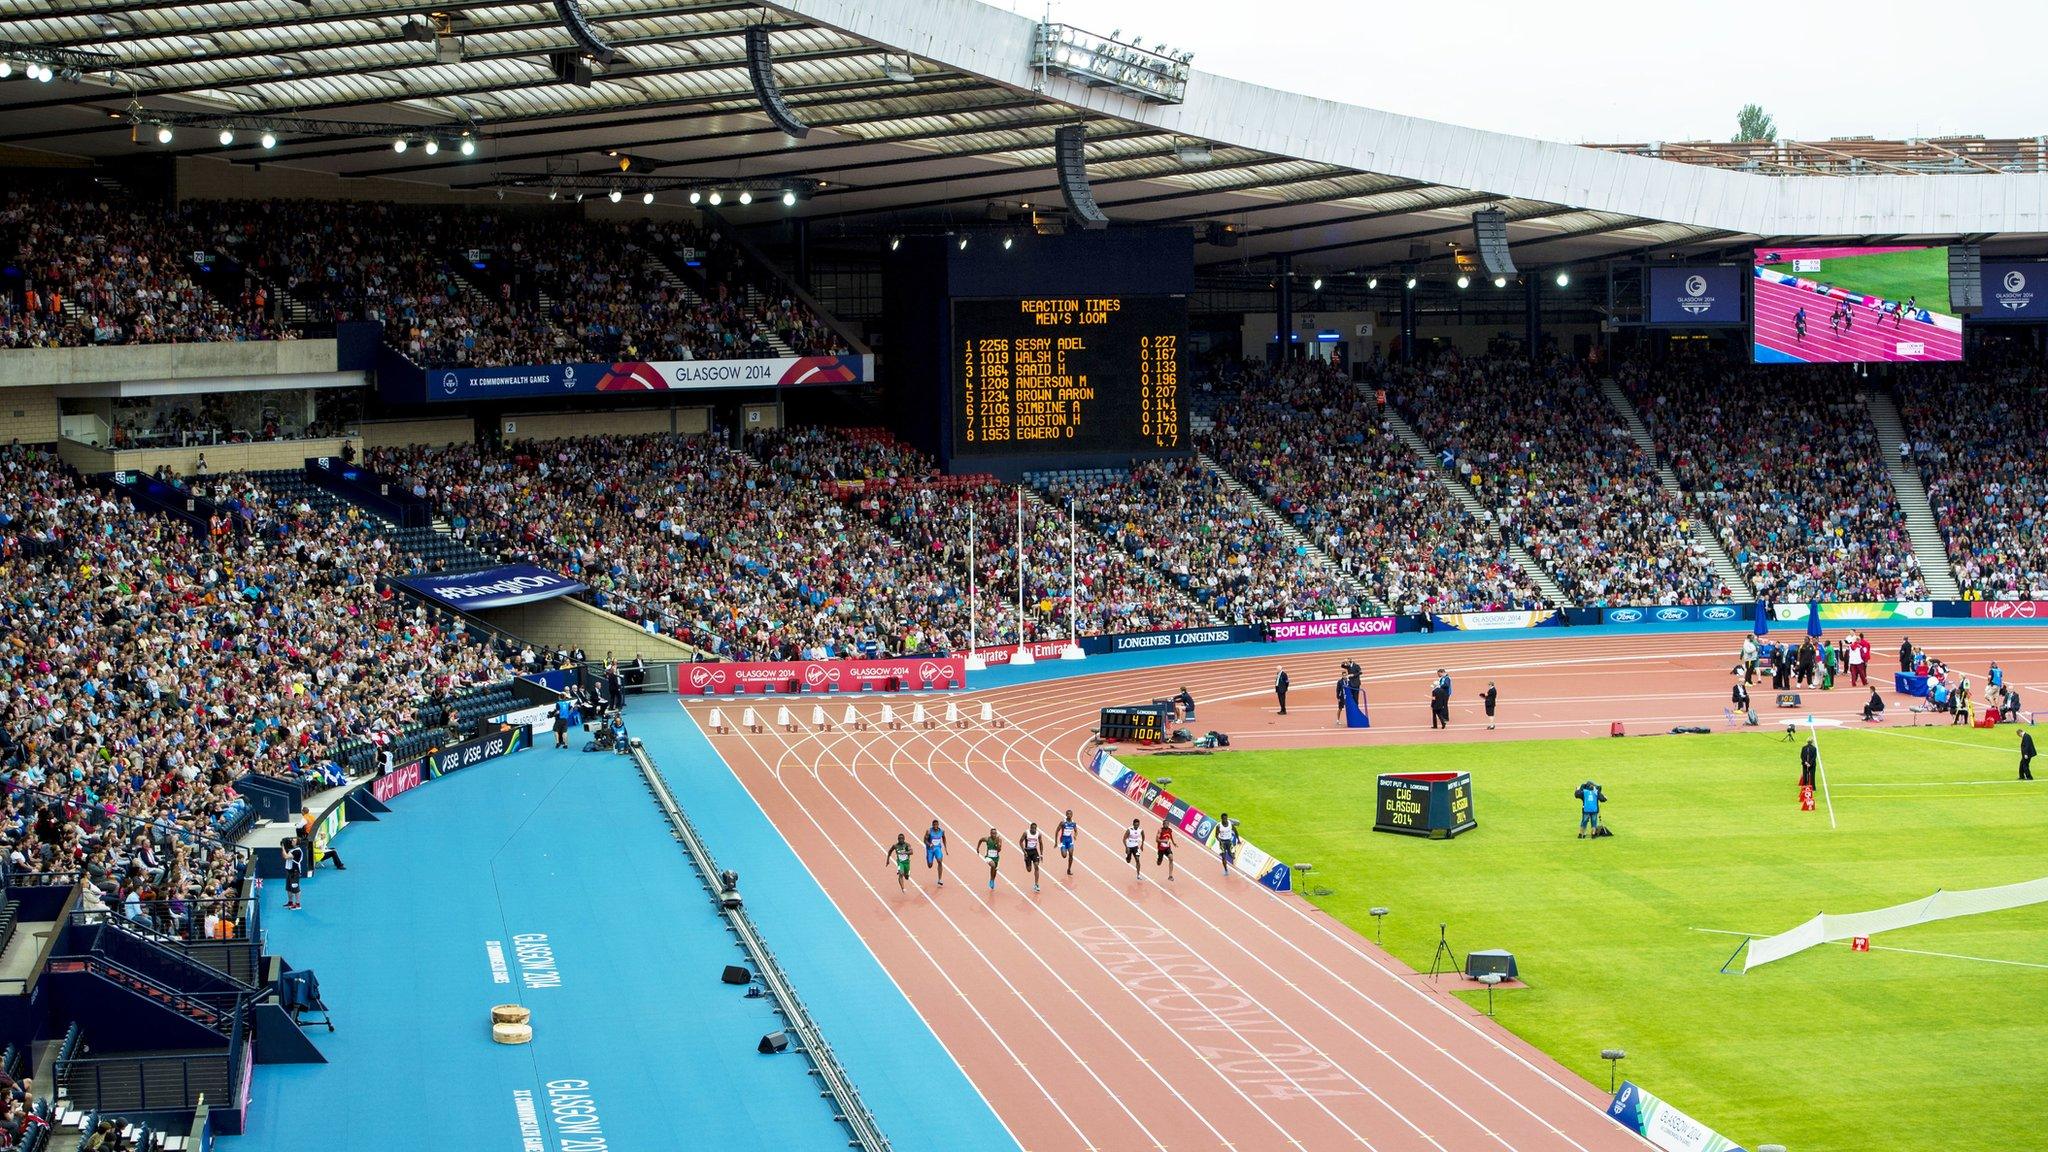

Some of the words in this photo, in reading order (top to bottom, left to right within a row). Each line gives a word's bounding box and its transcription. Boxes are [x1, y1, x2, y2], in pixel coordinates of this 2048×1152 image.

[1022, 300, 1078, 312] REACTION
[1086, 299, 1120, 311] TIMES
[1036, 313, 1071, 324] MEN'S
[1079, 312, 1106, 324] 100M
[1361, 326, 1368, 334] 6
[966, 340, 972, 352] 1
[980, 339, 1008, 351] 2256
[1015, 338, 1050, 350] SESAY
[1058, 338, 1085, 349] ADEL
[1142, 336, 1176, 348] 0.227
[966, 353, 973, 364] 2
[981, 352, 1008, 364] 1019
[1016, 351, 1051, 363] WALSH
[1058, 351, 1065, 362] C
[1142, 348, 1176, 360] 0.167
[676, 366, 742, 382] GLASGOW
[746, 366, 772, 380] 2014
[966, 366, 973, 377] 3
[981, 365, 1009, 377] 1864
[1016, 364, 1051, 376] SAAID
[1058, 363, 1065, 375] H
[1142, 361, 1176, 373] 0.133
[470, 378, 478, 386] XX
[480, 376, 529, 386] COMMONWEALTH
[530, 375, 550, 384] GAMES
[966, 378, 973, 390] 4
[981, 377, 1009, 389] 1208
[1016, 376, 1072, 388] ANDERSON
[1079, 375, 1086, 387] M
[1142, 373, 1176, 385] 0.196
[966, 391, 973, 403] 5
[981, 390, 1009, 402] 1234
[1016, 389, 1052, 401] BROWN
[1059, 388, 1093, 400] AARON
[1142, 386, 1176, 398] 0.207
[966, 404, 973, 416] 6
[981, 403, 1009, 415] 2106
[1016, 402, 1065, 414] SIMBINE
[1073, 401, 1080, 414] A
[1142, 398, 1176, 410] 0.141
[752, 412, 758, 420] 3
[967, 417, 973, 428] 7
[982, 416, 1009, 428] 1199
[1017, 414, 1066, 427] HOUSTON
[1073, 413, 1080, 425] H
[1143, 411, 1177, 423] 0.143
[508, 423, 514, 432] 2
[967, 430, 974, 441] 8
[982, 428, 1010, 441] 1953
[1017, 427, 1059, 439] EGWERO
[1066, 426, 1073, 437] O
[1143, 423, 1177, 435] 0.170
[1157, 435, 1177, 446] 4.7
[433, 576, 561, 600] #BringItOn
[1616, 612, 1636, 620] Ford
[1662, 611, 1682, 620] Ford
[1709, 610, 1729, 618] Ford
[1989, 602, 2011, 618] Virgin
[1309, 624, 1337, 636] MAKE
[1340, 620, 1392, 633] GLASGOW
[1118, 636, 1170, 649] LONGINES
[1176, 631, 1229, 645] LONGINES
[693, 670, 708, 684] Virgin
[736, 670, 776, 678] GLASGOW
[779, 669, 795, 677] 2014
[808, 668, 823, 682] Virgin
[850, 668, 891, 676] GLASGOW
[892, 667, 909, 675] 2014
[922, 665, 937, 679] Virgin
[1132, 715, 1154, 726] 4.8
[1134, 729, 1161, 739] 100M
[1396, 788, 1412, 800] CWG
[1386, 800, 1421, 814] GLASGOW
[1393, 813, 1412, 825] 2014
[513, 933, 556, 970] GLASGOW
[523, 971, 562, 989] 2014
[1072, 926, 1294, 1033] GLASGOW
[1196, 1043, 1368, 1101] 2014
[546, 1079, 602, 1133] GLASGOW
